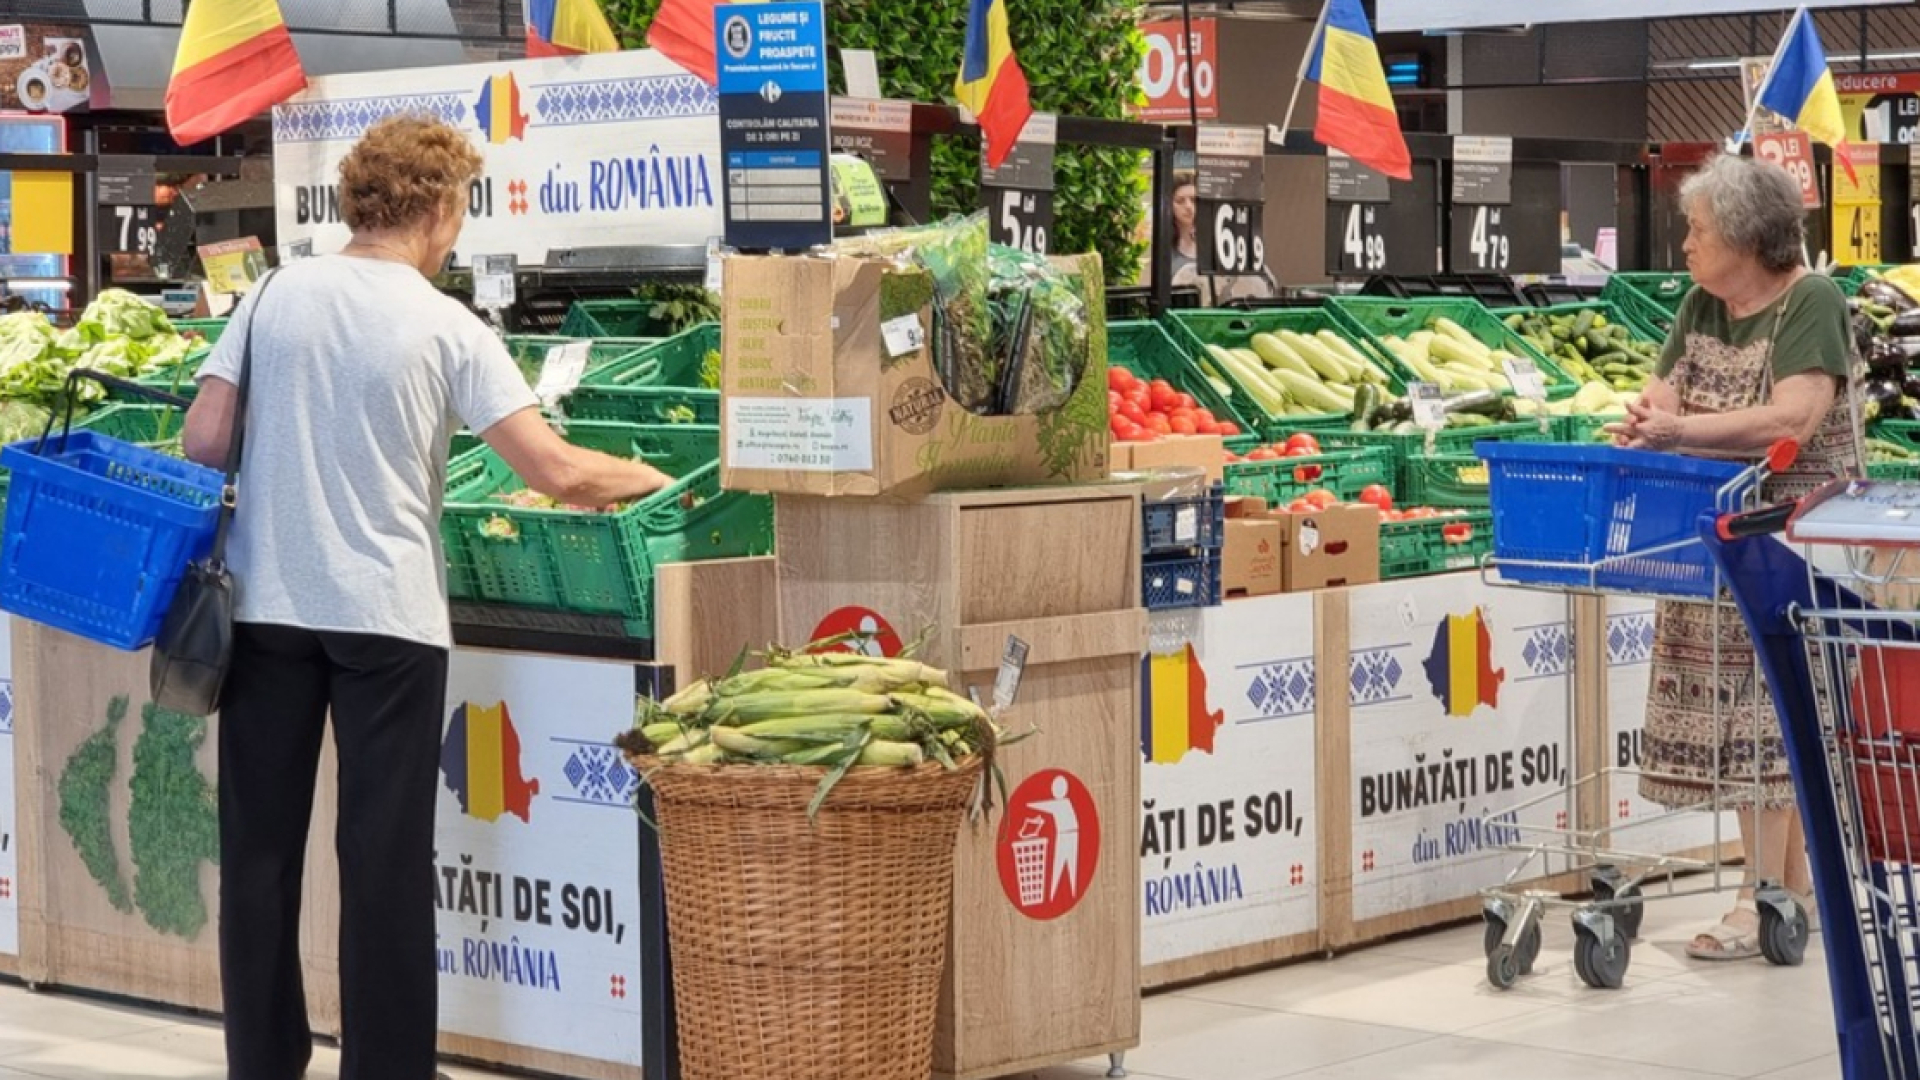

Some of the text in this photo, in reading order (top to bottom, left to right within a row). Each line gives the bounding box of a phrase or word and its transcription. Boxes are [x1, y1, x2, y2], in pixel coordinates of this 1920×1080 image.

[757, 13, 797, 25] LEGUME
[758, 28, 797, 42] FRUCTE
[1177, 32, 1202, 55] LEI
[1836, 75, 1898, 90] educere
[296, 143, 713, 225] BUN OI din ROMÂNIA
[115, 206, 133, 252] 7
[137, 227, 157, 256] 99
[1001, 190, 1021, 250] 5
[1215, 203, 1236, 270] 6
[1345, 203, 1363, 268] 4
[1366, 233, 1385, 270] 99
[1470, 205, 1488, 268] 4
[1490, 234, 1509, 270] 79
[1361, 743, 1567, 818] BUNĂTĂȚI DE SOI,
[1140, 788, 1303, 870] ĂȚI DE SOI,
[1412, 807, 1522, 865] din ROMÂNIA
[434, 851, 625, 945] TĂȚI DE SOI,
[1145, 860, 1243, 917] ROMÂNIA
[437, 933, 561, 993] in ROMÂNIA
